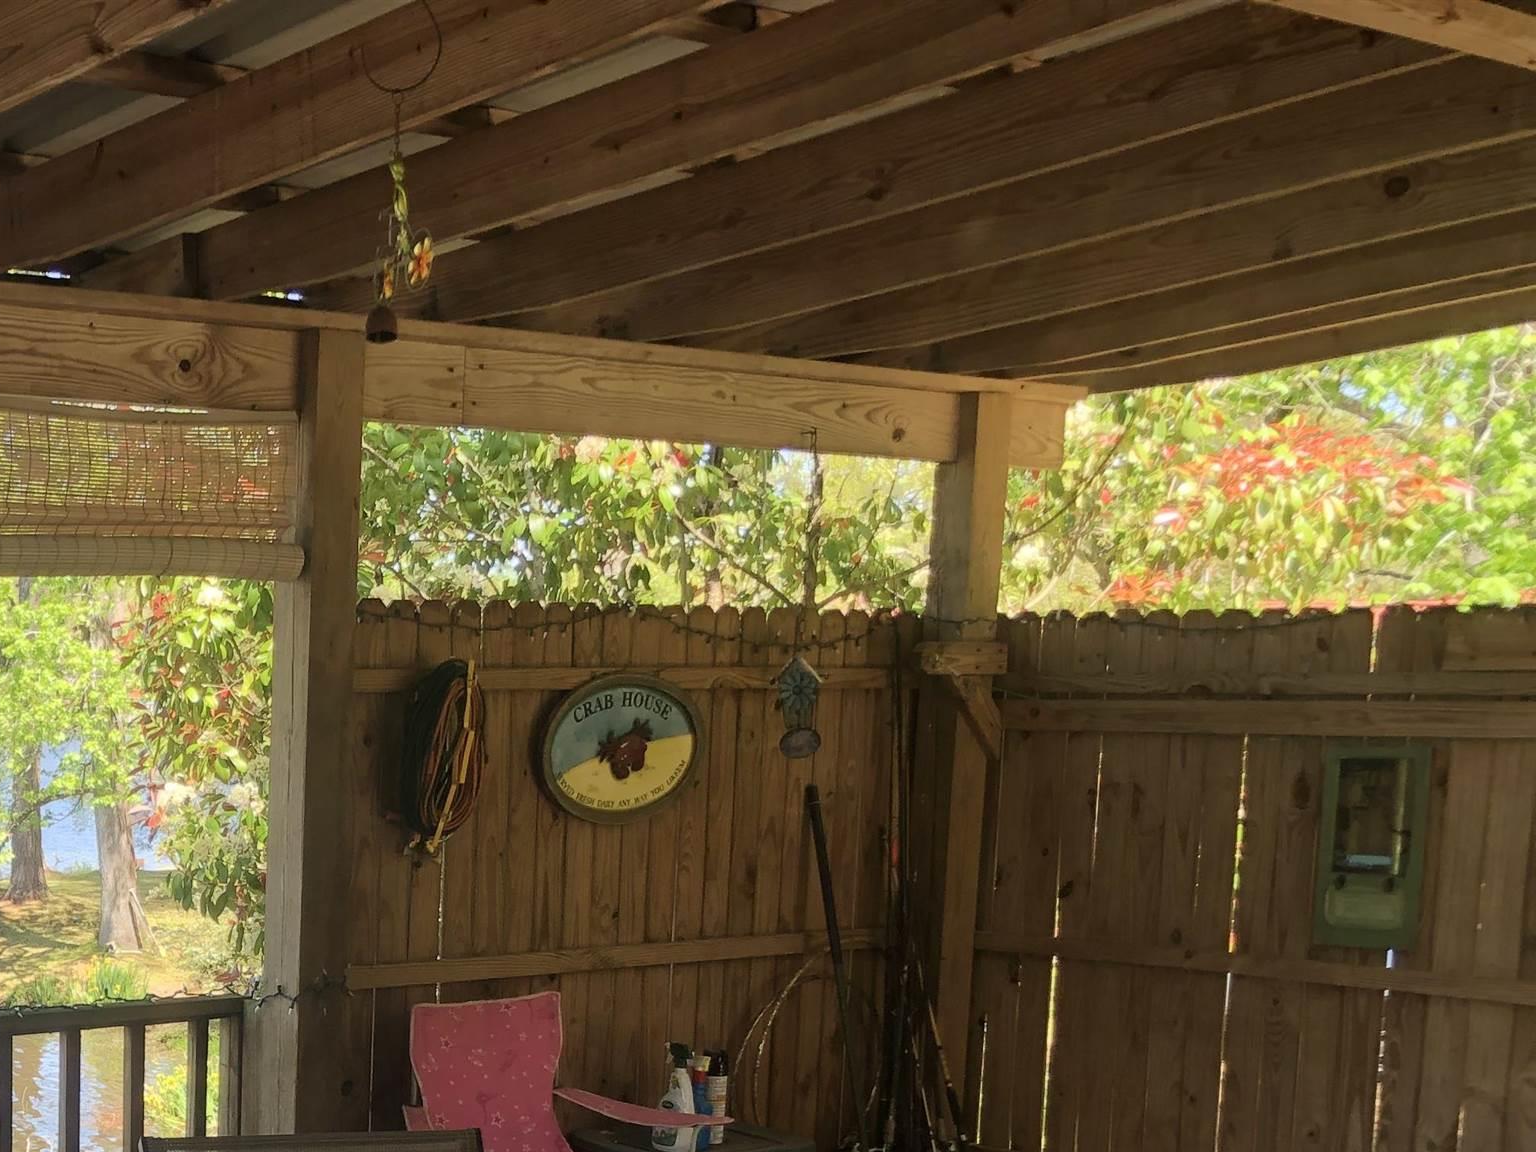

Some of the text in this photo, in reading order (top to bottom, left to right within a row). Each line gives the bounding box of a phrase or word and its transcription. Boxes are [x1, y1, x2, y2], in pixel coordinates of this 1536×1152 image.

[573, 691, 672, 723] CRAB HOUSE
[650, 783, 665, 796] YOU
